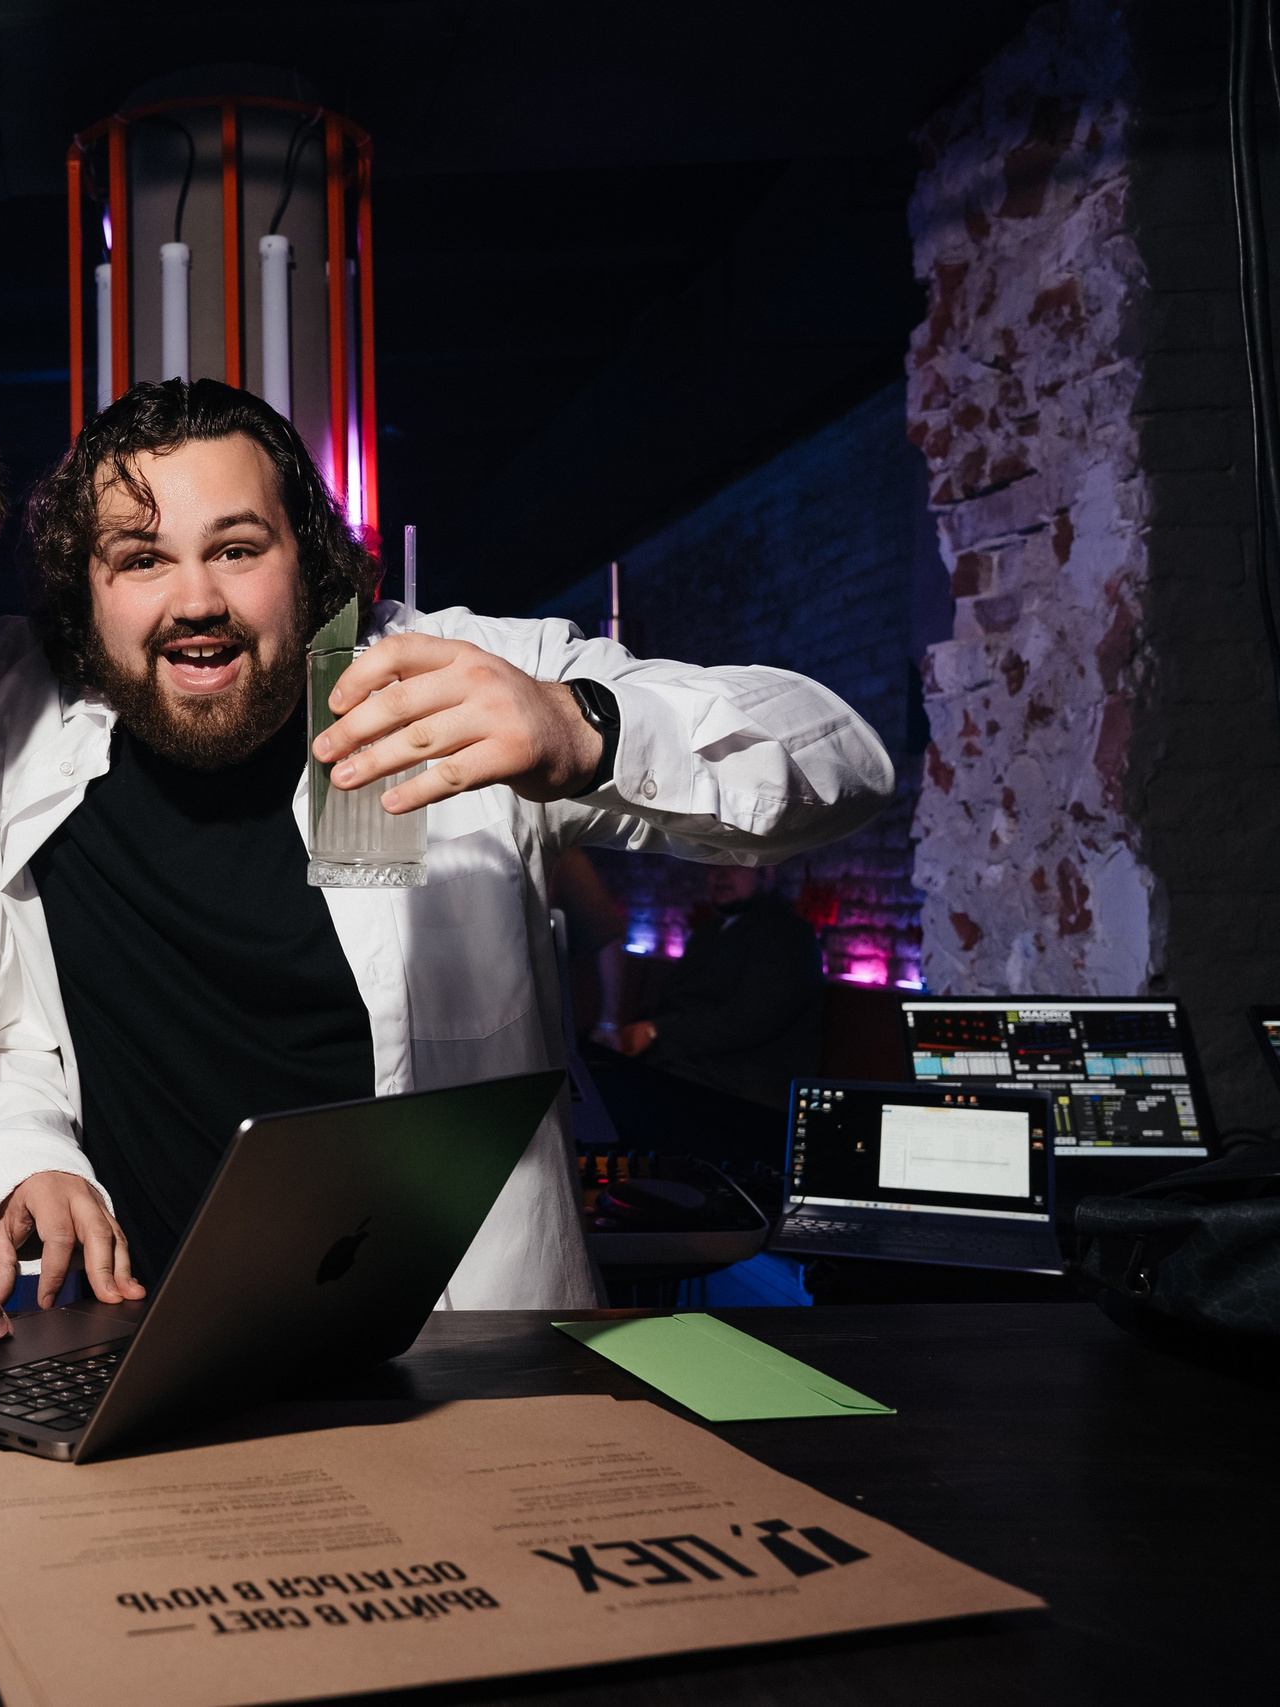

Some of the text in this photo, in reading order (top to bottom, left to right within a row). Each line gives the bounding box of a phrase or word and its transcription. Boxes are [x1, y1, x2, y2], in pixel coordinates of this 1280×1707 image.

[531, 1533, 758, 1593] ЦЕХ
[116, 1560, 468, 1614] ОСТАТЬСЯ В НОЧЬ
[349, 1587, 501, 1623] ВЫЙТИ
[207, 1606, 311, 1636] СВЕТ
[314, 1603, 349, 1626] В
